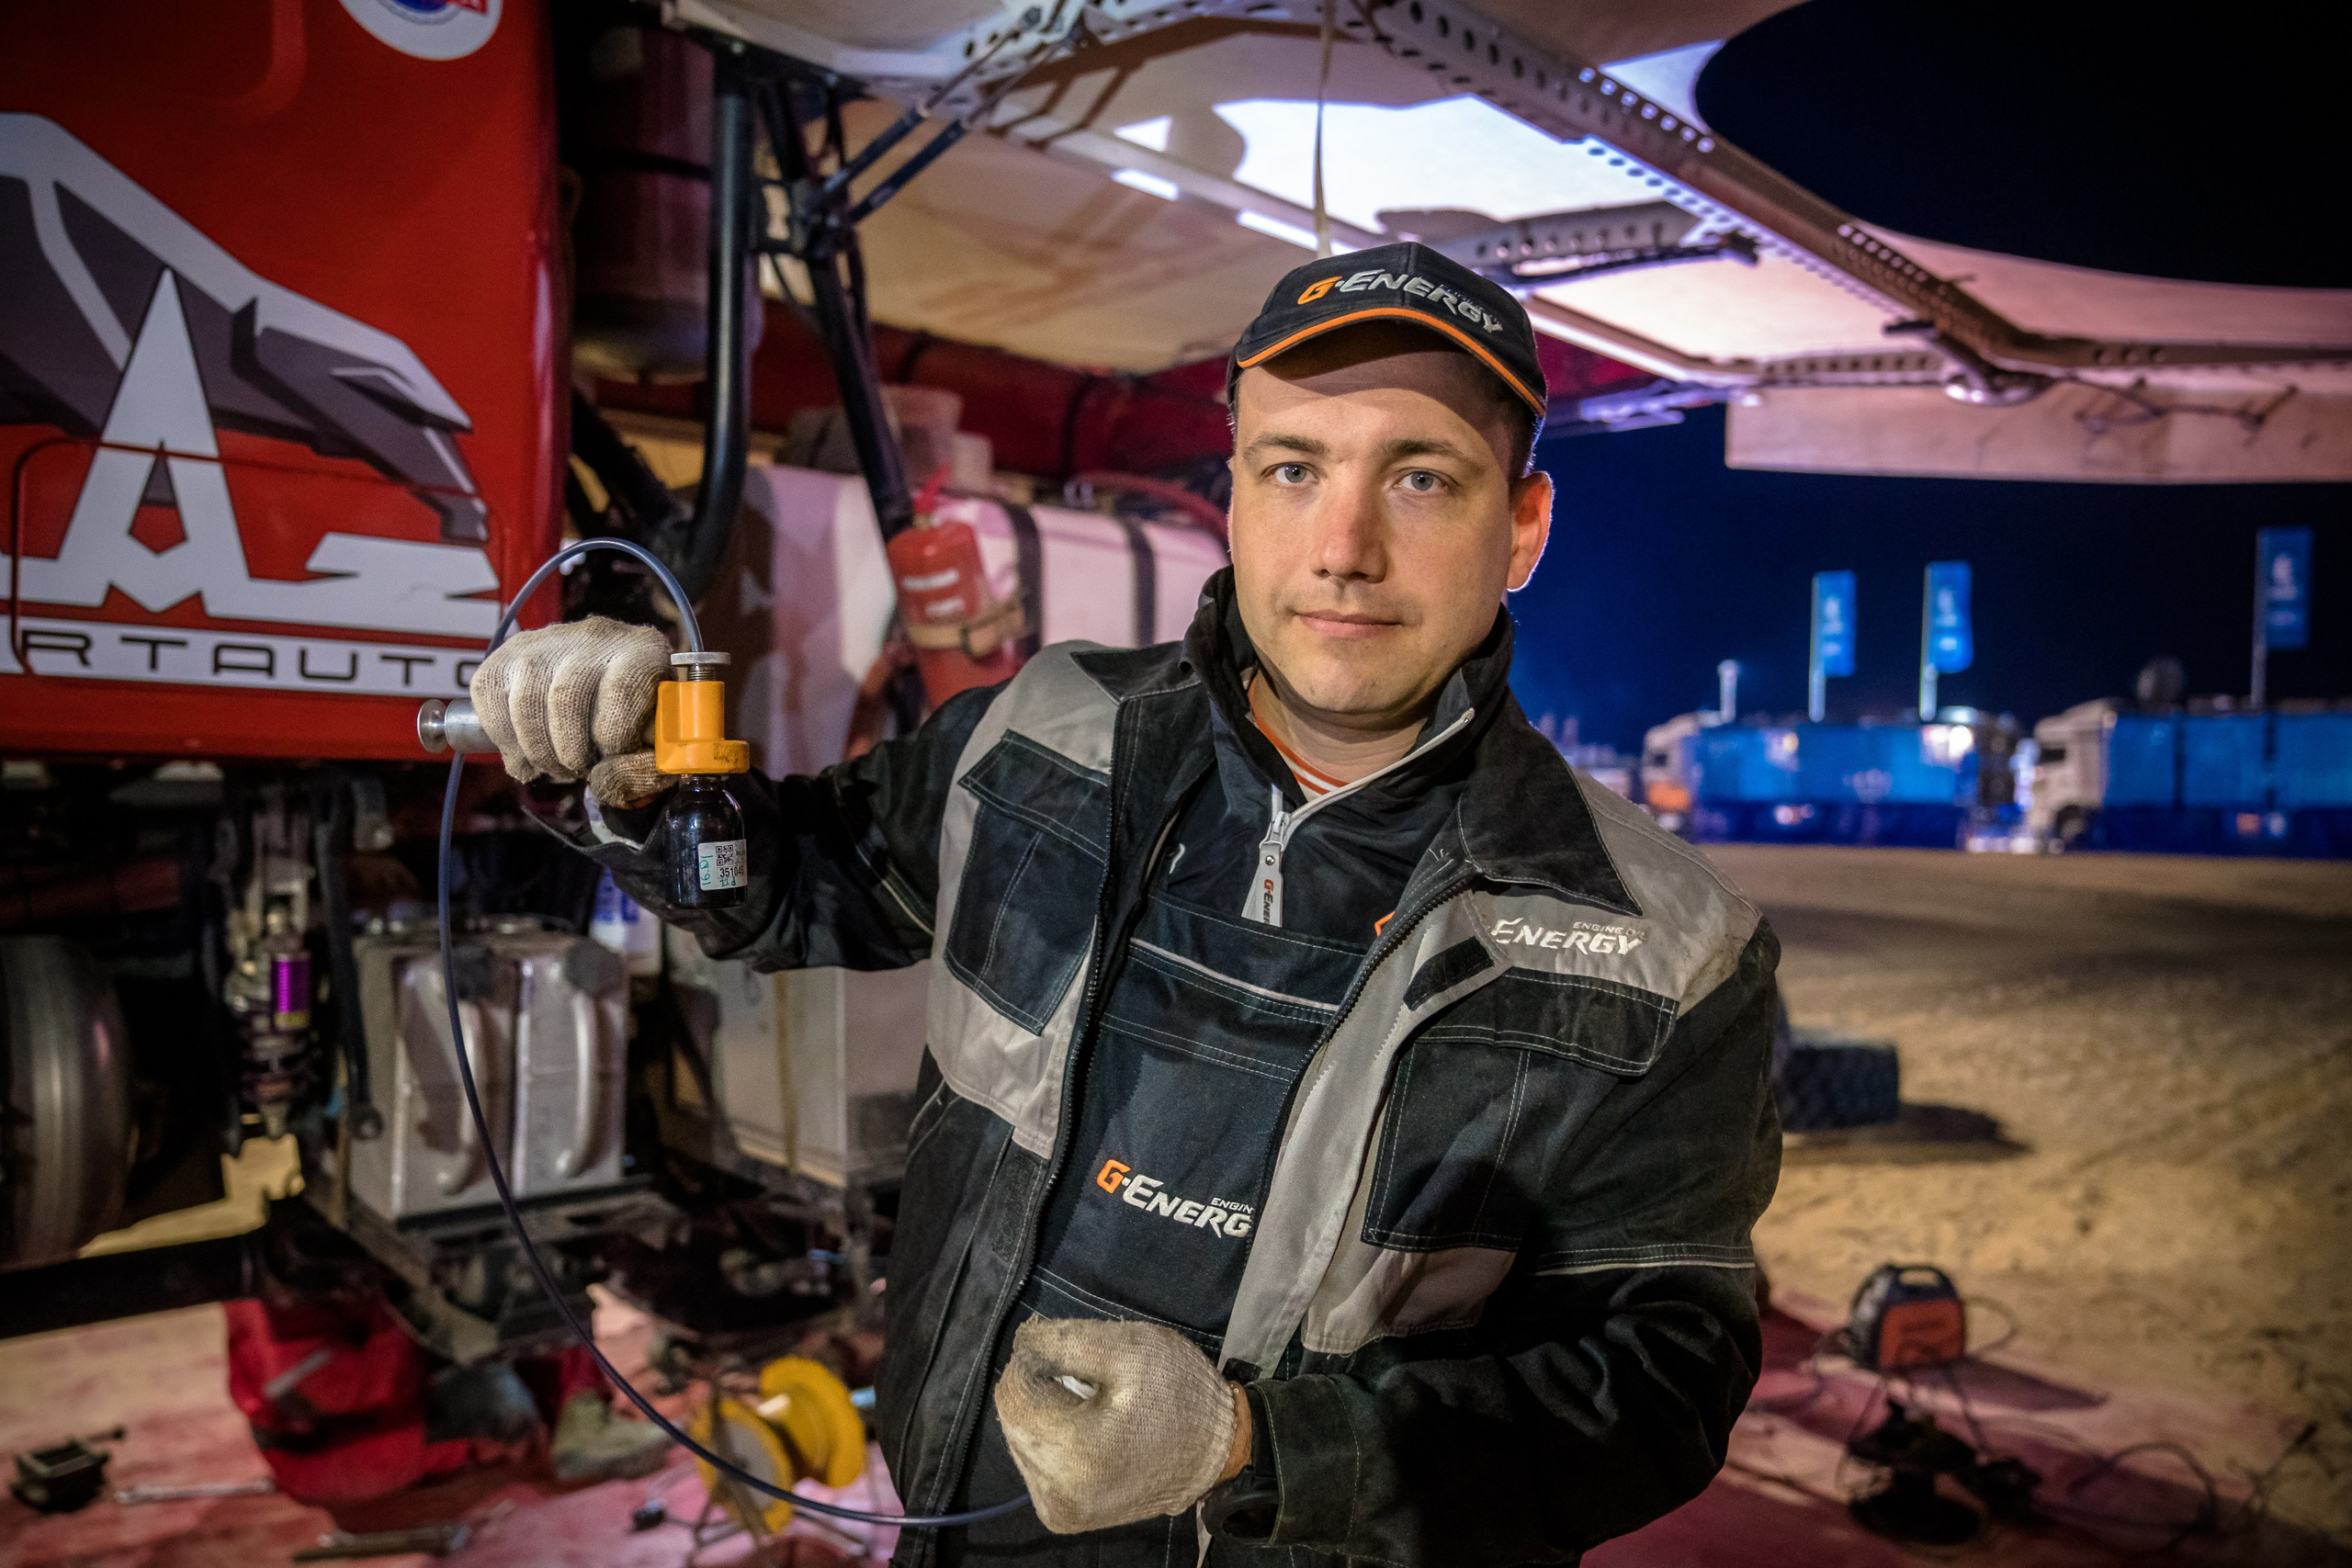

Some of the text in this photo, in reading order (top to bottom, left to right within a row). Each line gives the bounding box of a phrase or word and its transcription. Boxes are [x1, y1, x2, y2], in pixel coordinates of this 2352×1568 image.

[1573, 921, 1624, 934] ENGINE
[1096, 1159, 1252, 1238] G-ENERG
[1210, 1197, 1253, 1214] ENGIN
